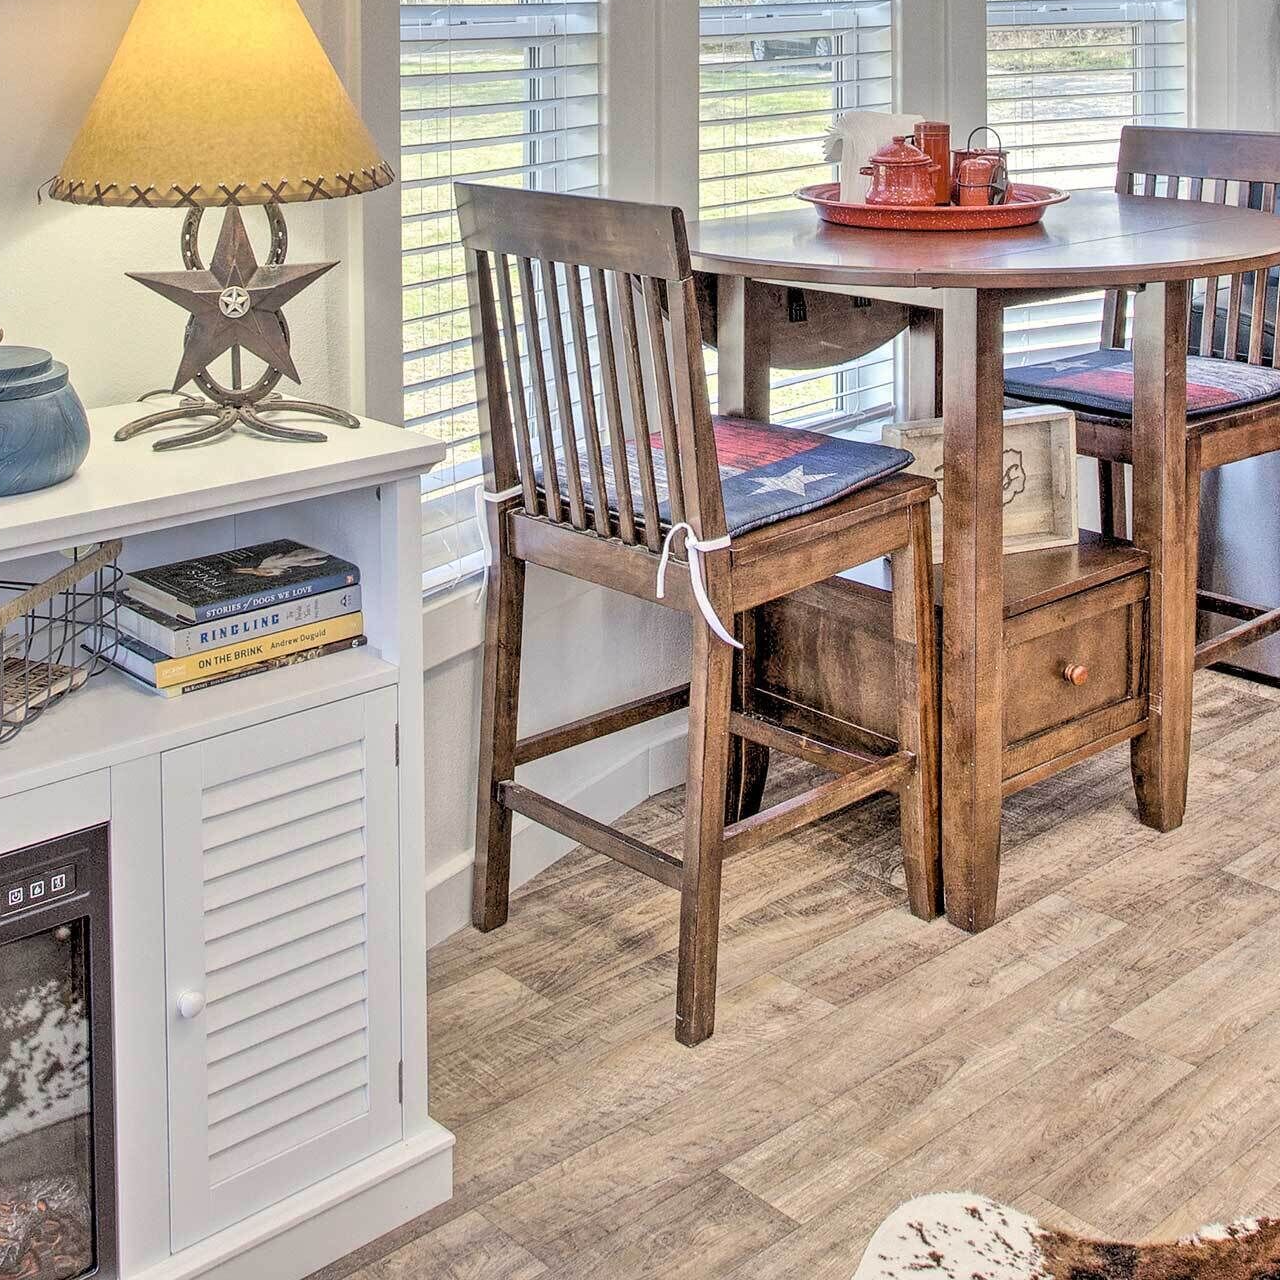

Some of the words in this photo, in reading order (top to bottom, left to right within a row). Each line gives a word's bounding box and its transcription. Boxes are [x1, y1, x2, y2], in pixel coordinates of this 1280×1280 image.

[206, 601, 242, 618] STORIES
[253, 593, 276, 606] DOGS
[276, 589, 291, 600] WE
[292, 585, 313, 597] LOVE
[200, 613, 280, 644] RINGLING
[198, 656, 213, 669] ON
[214, 651, 233, 665] THE
[234, 644, 264, 660] BRINK
[270, 636, 298, 650] Andrew
